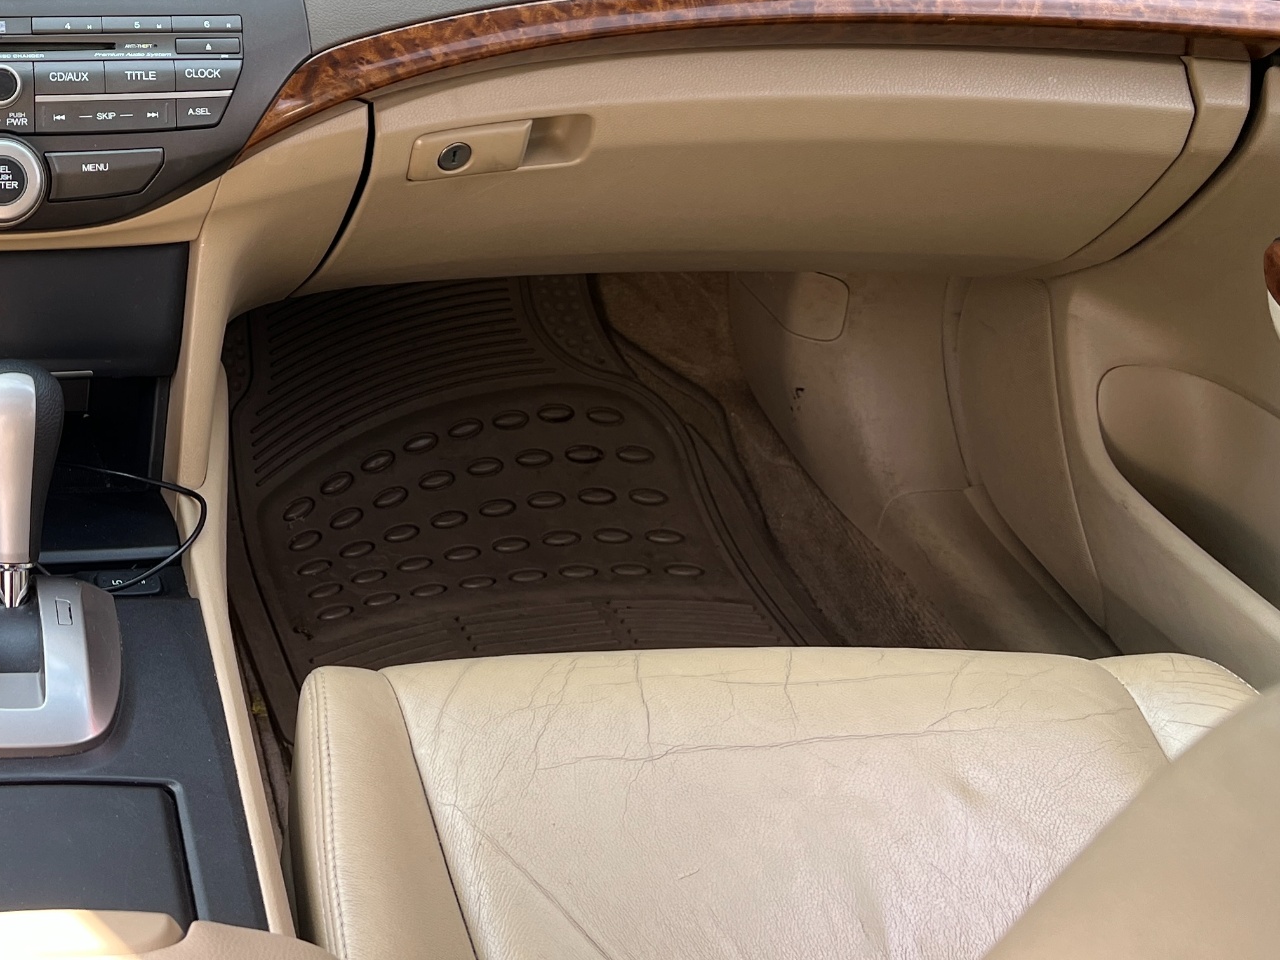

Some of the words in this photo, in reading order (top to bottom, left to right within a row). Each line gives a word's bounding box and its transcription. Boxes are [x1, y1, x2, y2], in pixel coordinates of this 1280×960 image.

[50, 72, 89, 82] CD/AUX
[125, 71, 156, 80] TITLE
[185, 69, 221, 78] CLOCK
[96, 112, 116, 120] SKIP
[188, 108, 211, 116] A.SEL
[6, 117, 28, 126] PWR
[82, 164, 109, 172] MENU
